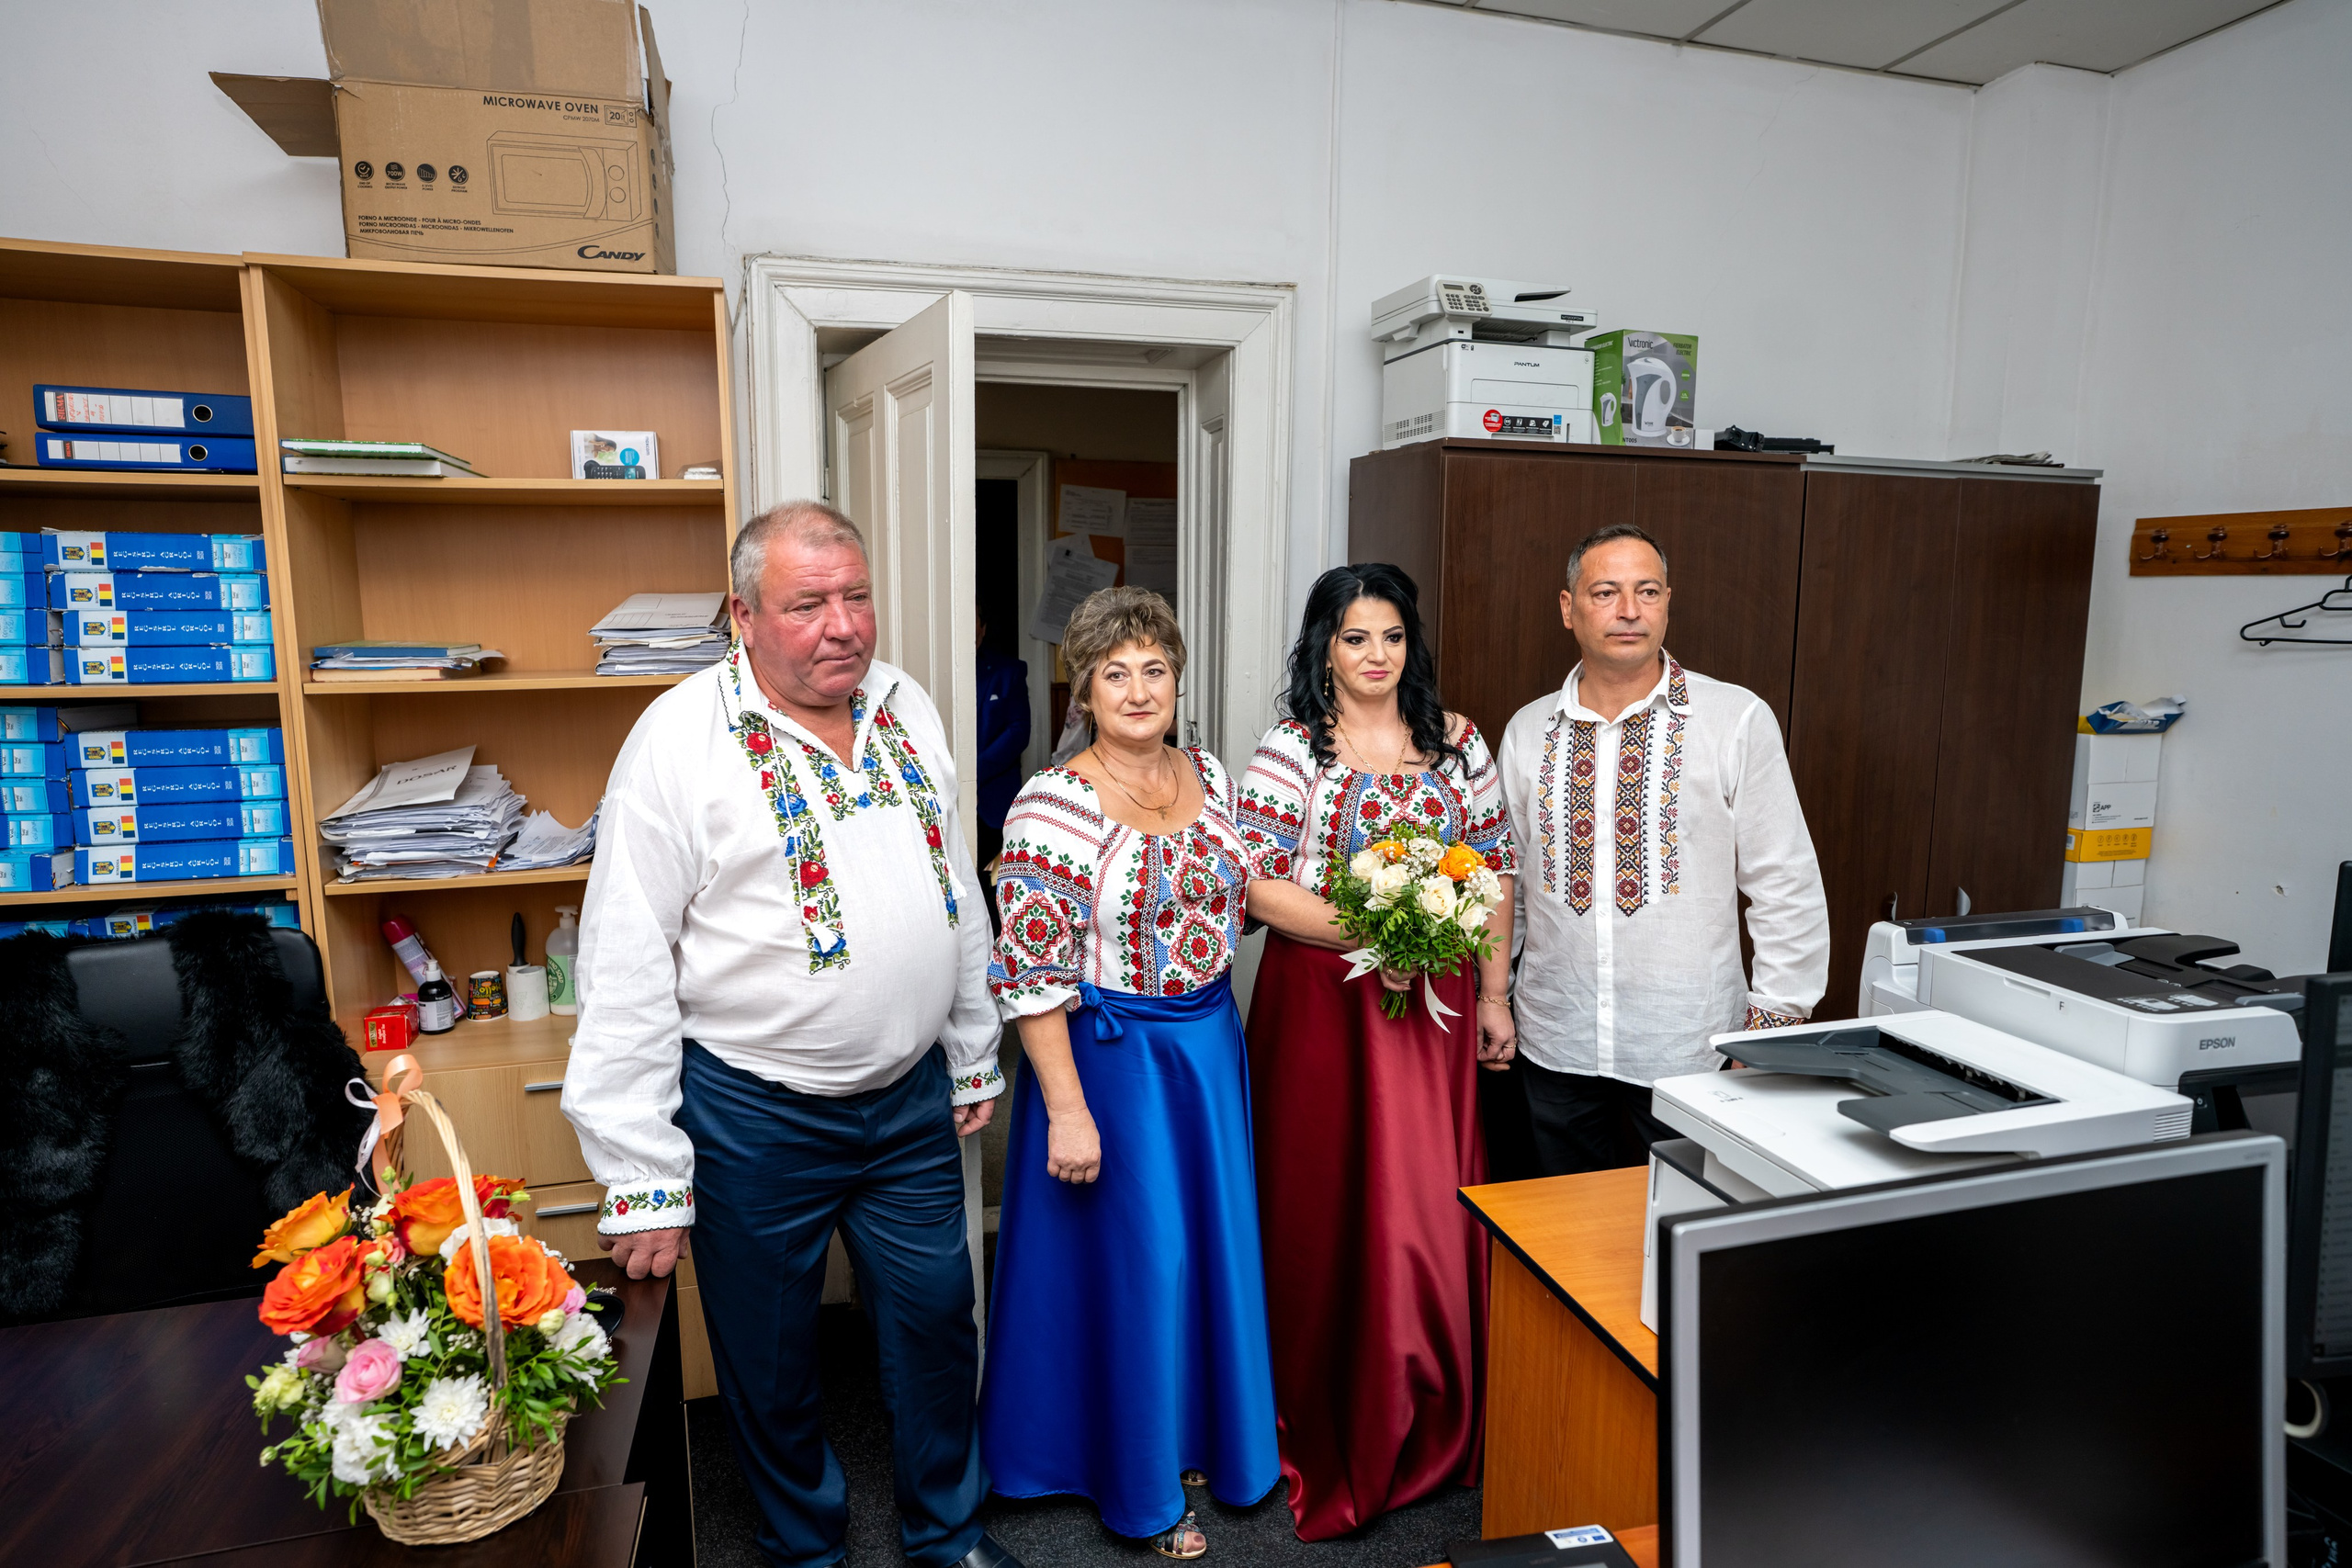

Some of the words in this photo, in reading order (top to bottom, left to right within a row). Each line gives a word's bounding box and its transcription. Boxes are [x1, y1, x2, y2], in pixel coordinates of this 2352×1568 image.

[483, 96, 561, 111] MICROWAVE
[565, 102, 599, 114] OVEN
[577, 245, 646, 261] CANDY
[1627, 337, 1654, 350] Victronic
[57, 395, 66, 420] SIGMA
[396, 764, 458, 785] DOSAR
[144, 821, 185, 829] REGISTRUL
[142, 861, 183, 869] REGISTRUL
[555, 970, 564, 983] SOAP
[2199, 1037, 2236, 1050] EPSON
